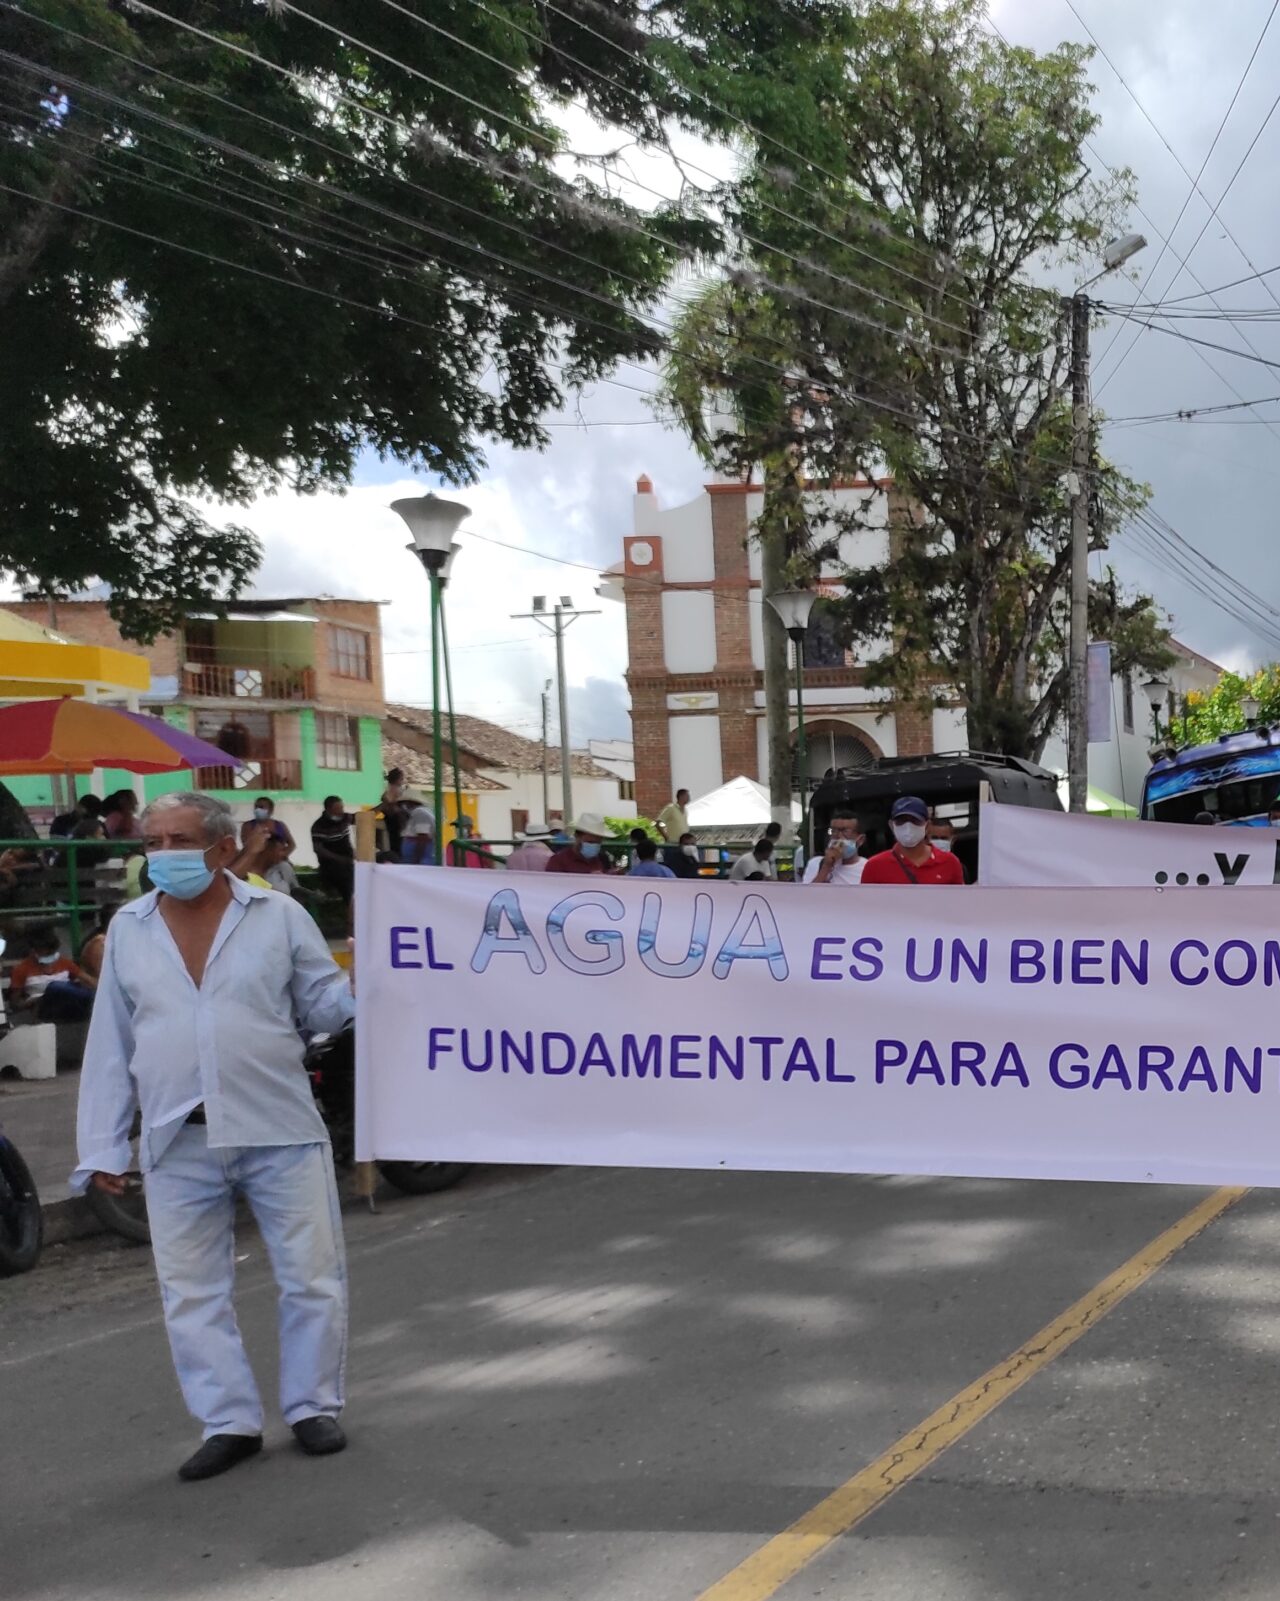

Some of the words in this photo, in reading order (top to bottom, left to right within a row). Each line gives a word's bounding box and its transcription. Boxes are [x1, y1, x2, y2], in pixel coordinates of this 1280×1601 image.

[389, 926, 454, 971] EL
[470, 888, 790, 981] AGUA
[810, 937, 884, 982] ES
[905, 937, 988, 984] UN
[1010, 938, 1149, 986] BIEN
[428, 1027, 856, 1083] FUNDAMENTAL
[875, 1039, 1030, 1088] PARA
